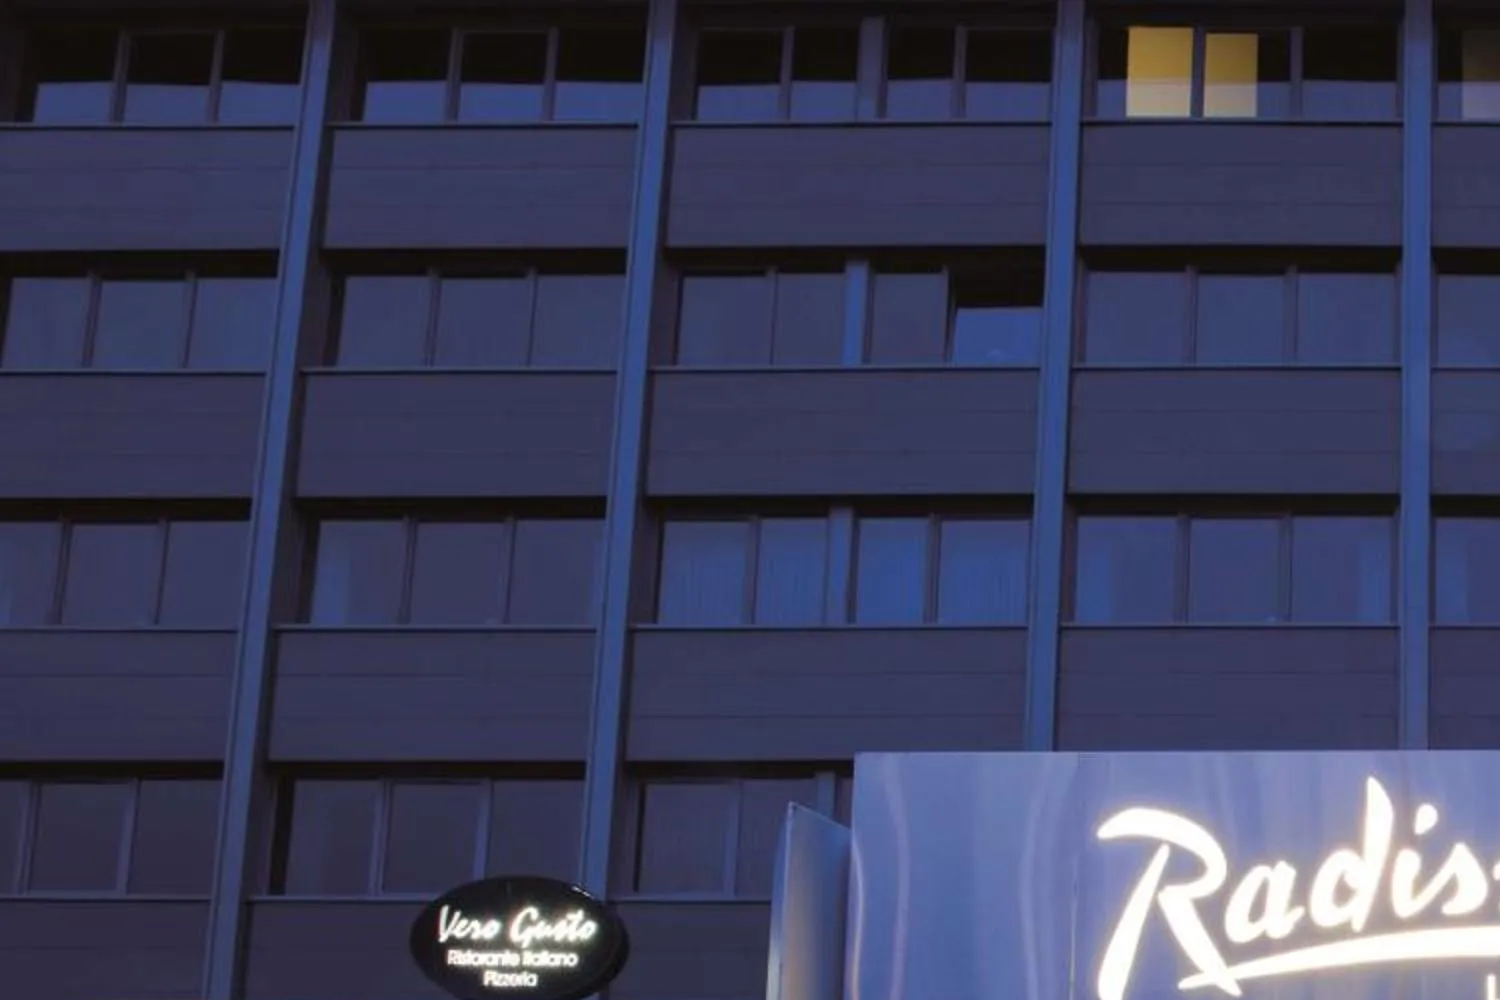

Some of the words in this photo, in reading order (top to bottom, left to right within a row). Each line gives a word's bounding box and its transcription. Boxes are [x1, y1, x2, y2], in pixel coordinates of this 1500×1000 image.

[437, 904, 502, 943] Vero
[510, 906, 598, 948] Gusto
[447, 949, 520, 967] Ristorante
[522, 951, 579, 967] Italiano
[483, 971, 538, 987] Pizzeria
